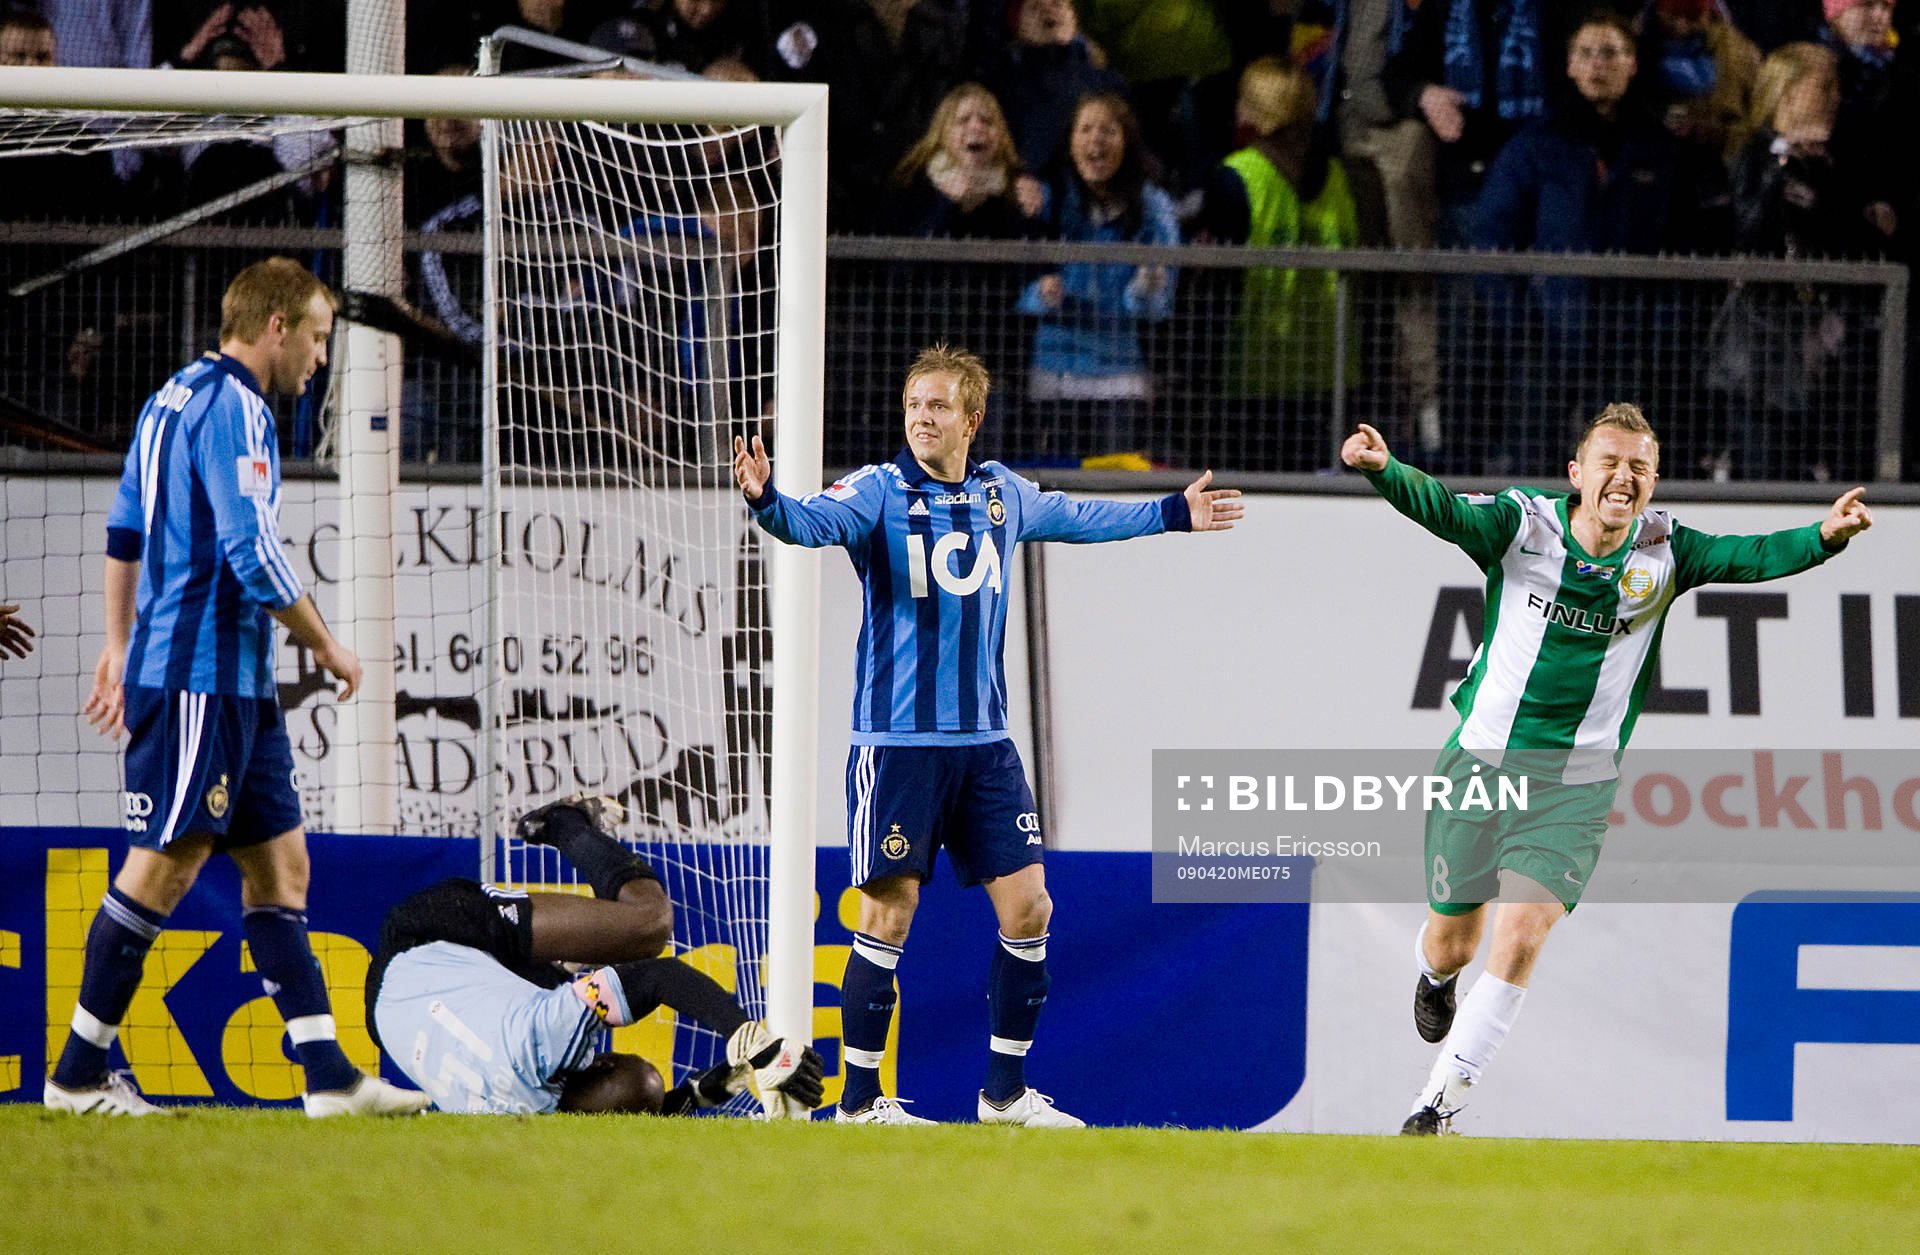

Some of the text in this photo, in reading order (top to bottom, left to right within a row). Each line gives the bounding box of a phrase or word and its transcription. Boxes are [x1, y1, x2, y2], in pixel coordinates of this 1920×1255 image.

[934, 492, 981, 504] stadium
[906, 530, 1001, 598] ICA
[1527, 592, 1634, 635] FINLUX
[449, 634, 522, 674] 60
[542, 633, 588, 675] 52
[605, 634, 655, 676] 96
[1430, 854, 1452, 903] 8
